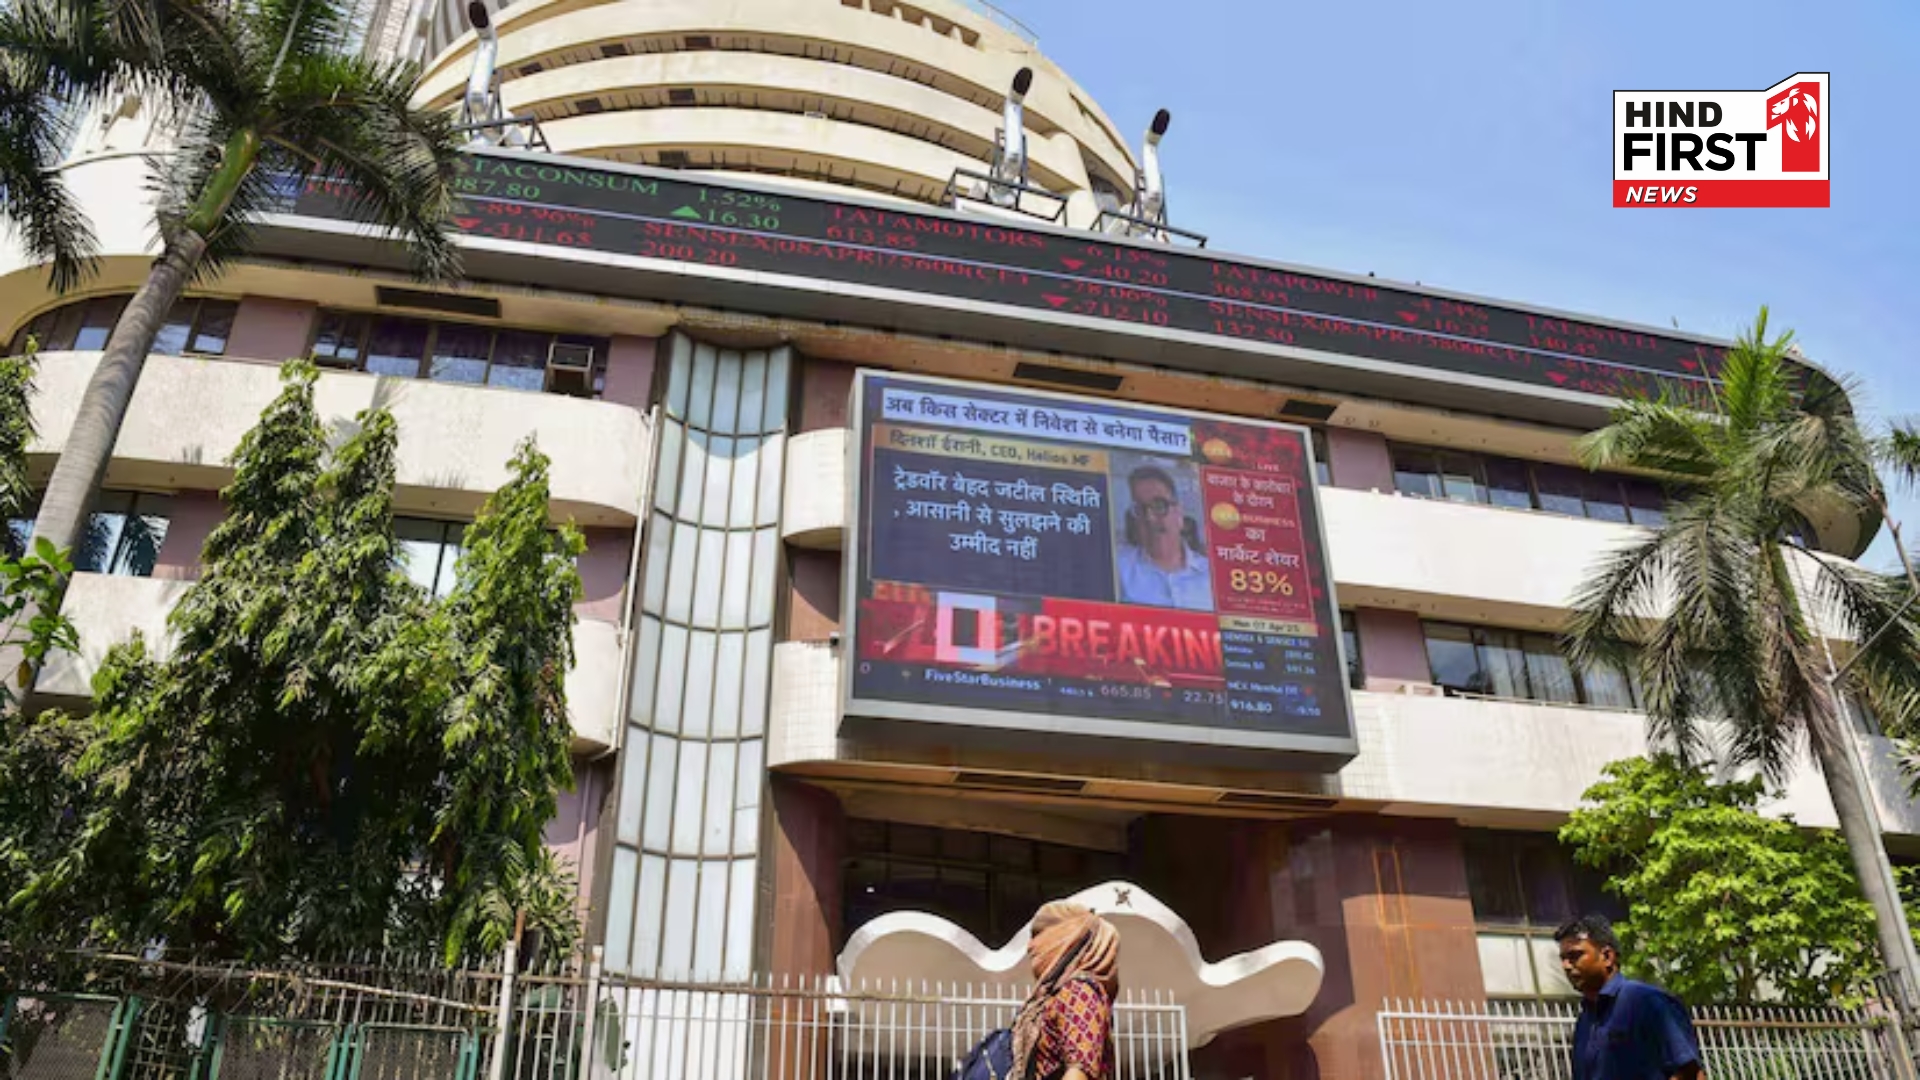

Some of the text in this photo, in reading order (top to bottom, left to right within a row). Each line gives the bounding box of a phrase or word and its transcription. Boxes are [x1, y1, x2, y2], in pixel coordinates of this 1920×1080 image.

[456, 156, 659, 196] TACONSUM
[699, 188, 781, 212] 1.52%
[708, 208, 780, 230] 16.30
[826, 205, 1046, 248] TATAMOTORS
[641, 241, 738, 266] 200.20
[885, 396, 913, 413] अब
[920, 397, 957, 419] किस
[963, 401, 1009, 425] सेक्टर
[1014, 404, 1028, 425] में
[1033, 410, 1079, 433] निवेश
[1083, 415, 1099, 436] से
[1103, 420, 1143, 442] बनेगा
[953, 471, 990, 498] बेहद
[1051, 482, 1101, 508] स्थिति
[906, 499, 971, 522] आसानी
[976, 505, 993, 526] से
[997, 510, 1061, 534] सुलझने
[1066, 512, 1091, 536] की
[949, 530, 1039, 561] उम्मीद नहीं
[1244, 527, 1266, 543] का
[1230, 568, 1294, 597] 83%
[924, 667, 1042, 691] FiveStarBusiness
